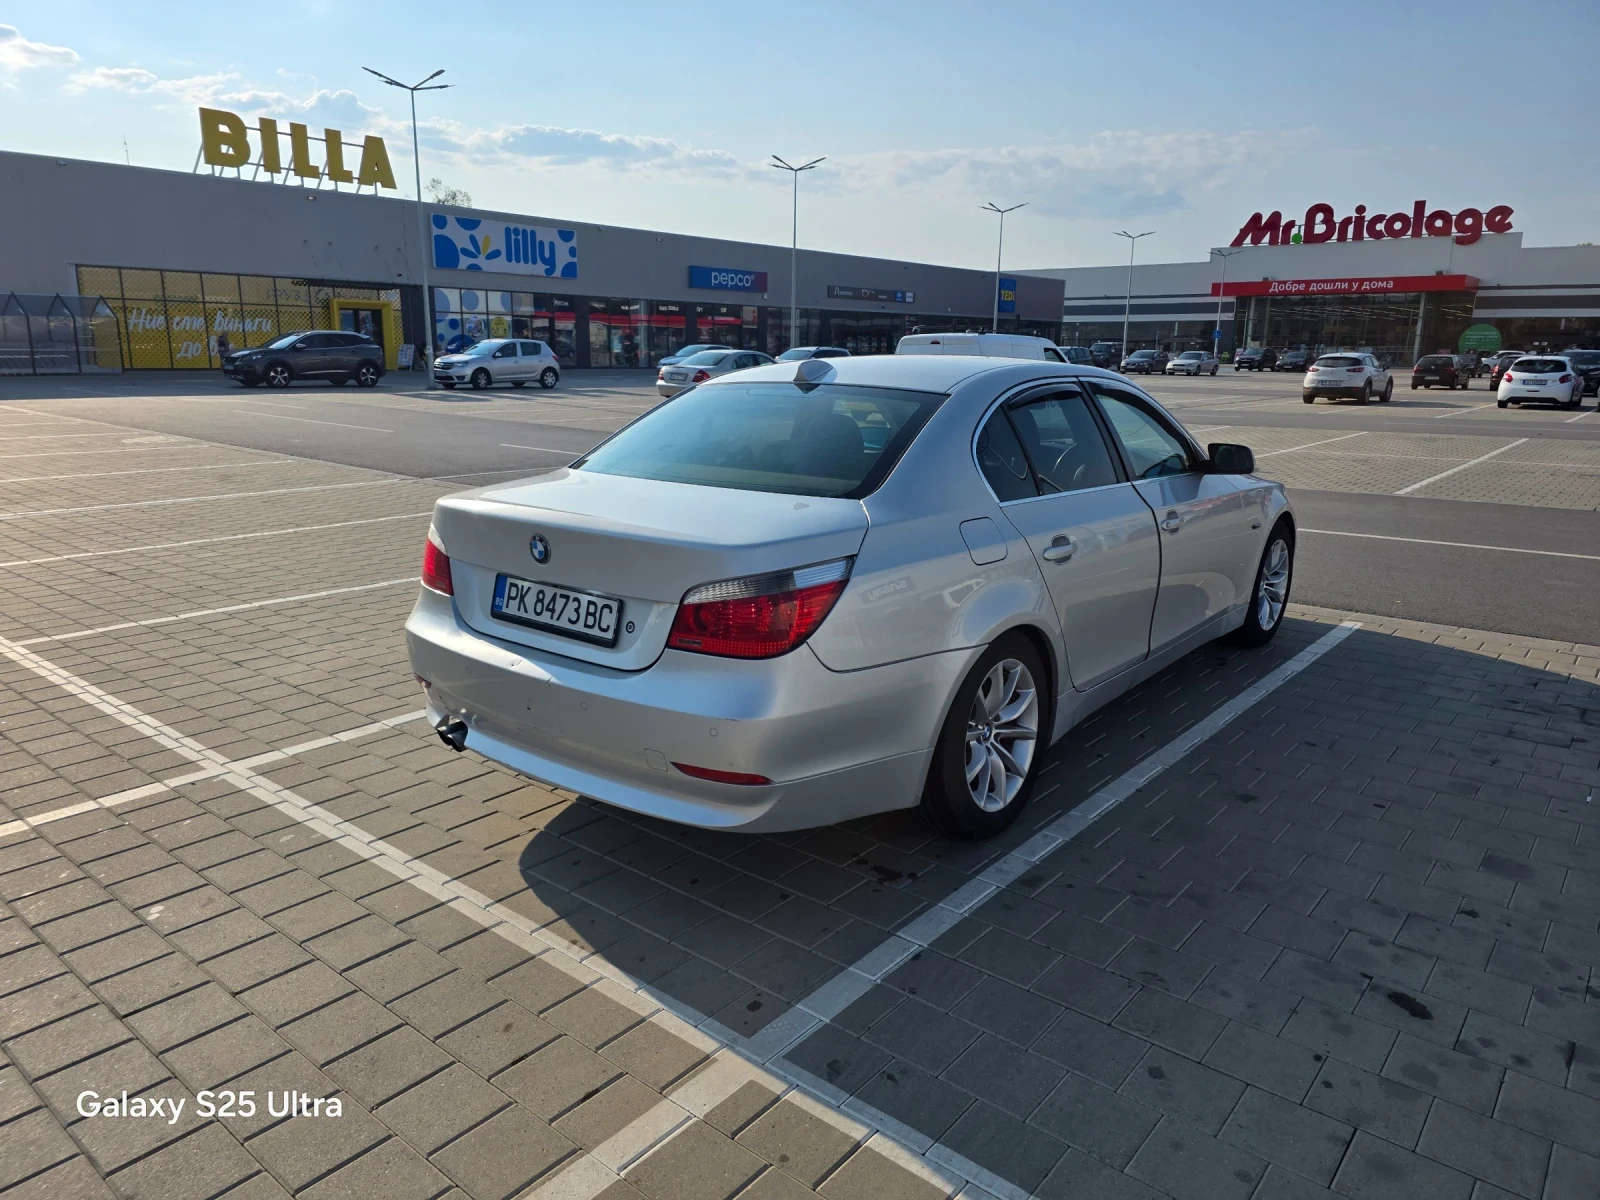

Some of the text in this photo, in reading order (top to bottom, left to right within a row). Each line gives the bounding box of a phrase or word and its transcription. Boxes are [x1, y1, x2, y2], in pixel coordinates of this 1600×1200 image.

[199, 107, 397, 190] BILLA
[505, 226, 556, 276] lilly
[1001, 289, 1015, 301] TEDi
[1269, 279, 1393, 293] Добре дошли у дома
[128, 308, 166, 333] Ние
[495, 597, 503, 606] BG
[505, 582, 613, 633] PK 8473 BC
